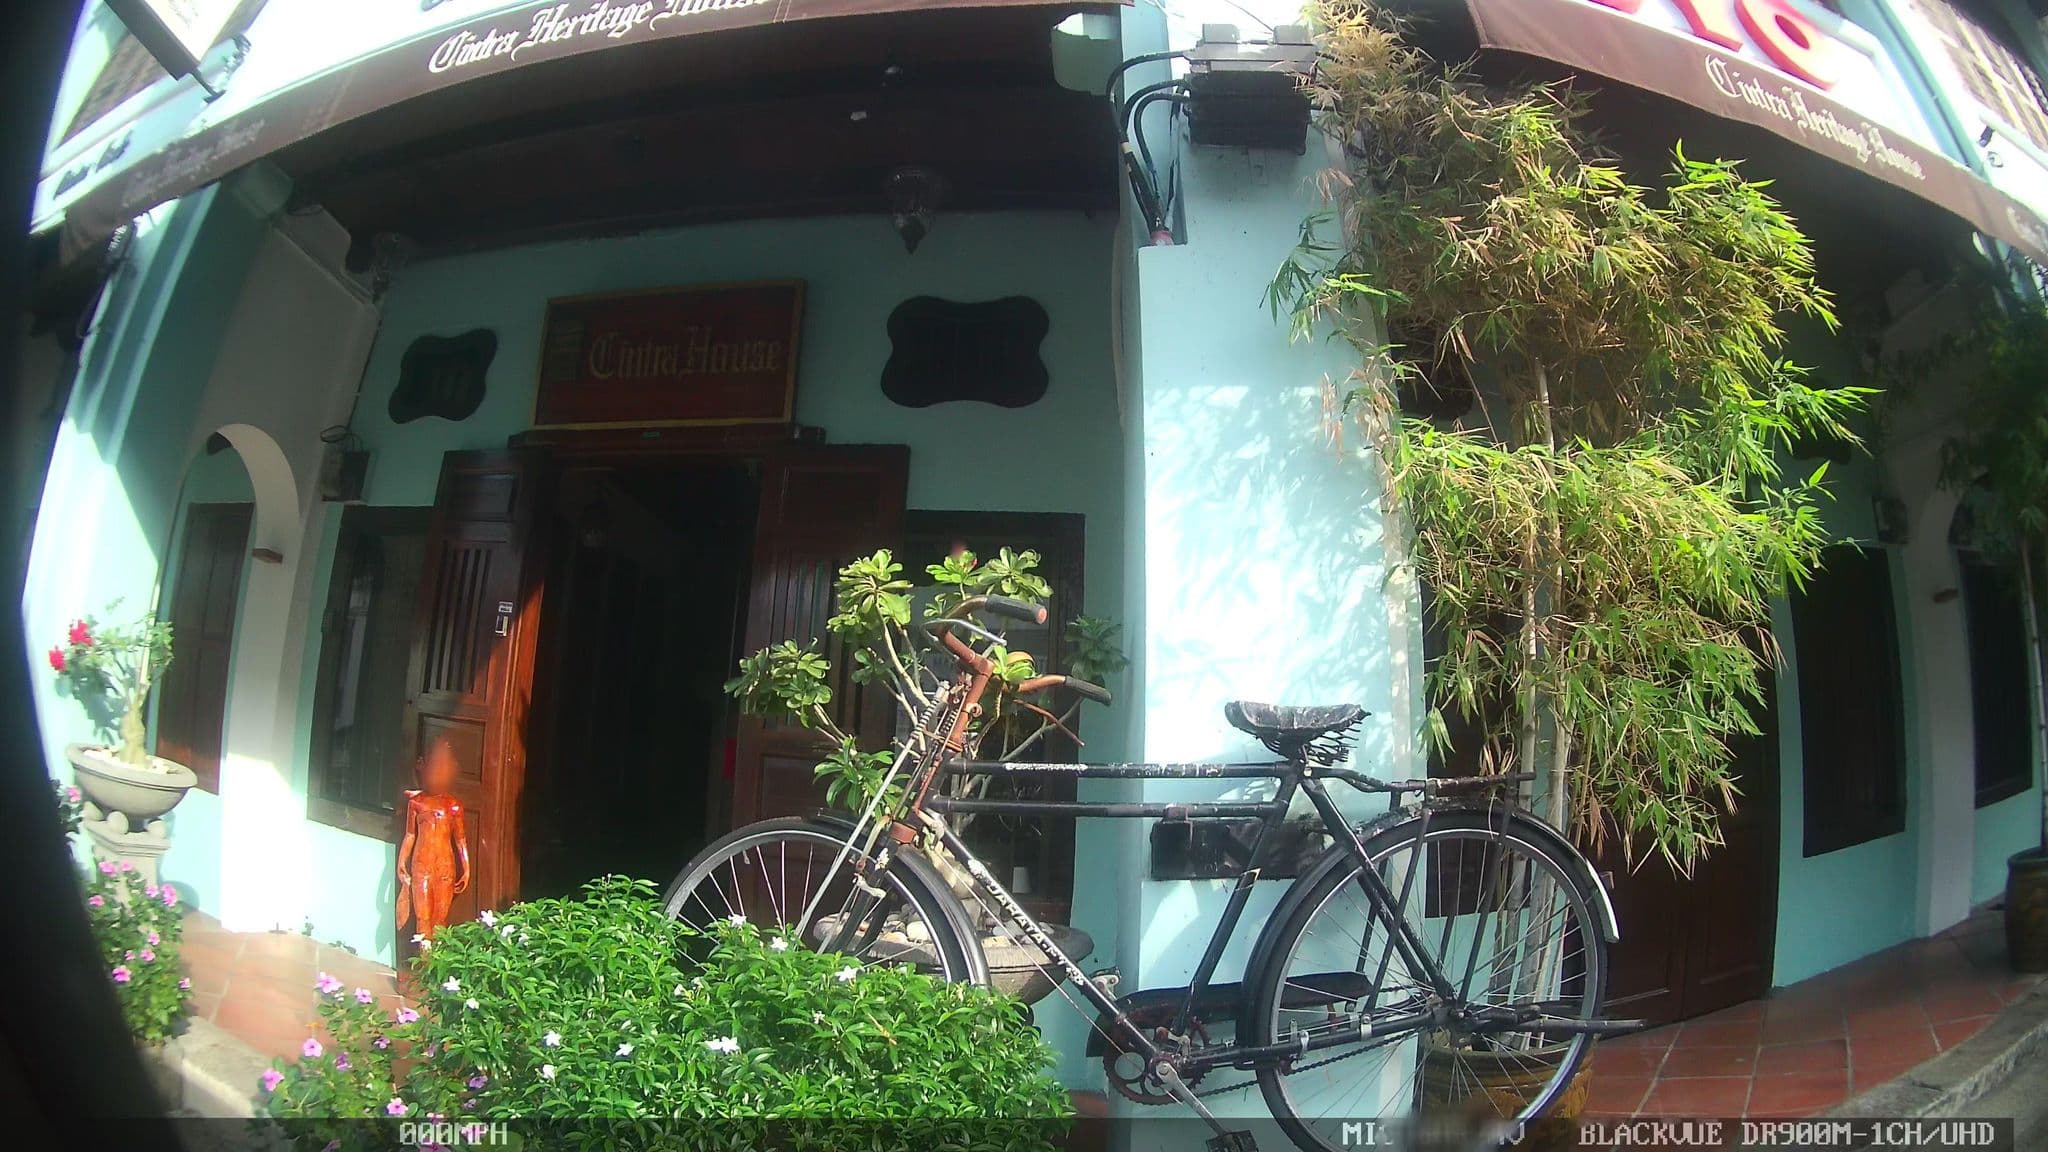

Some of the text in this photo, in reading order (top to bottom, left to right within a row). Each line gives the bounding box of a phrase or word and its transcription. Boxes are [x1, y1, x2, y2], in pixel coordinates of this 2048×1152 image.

[428, 29, 519, 73] Cintra
[1705, 54, 1793, 120] Cintra
[588, 324, 783, 380] Cintra House
